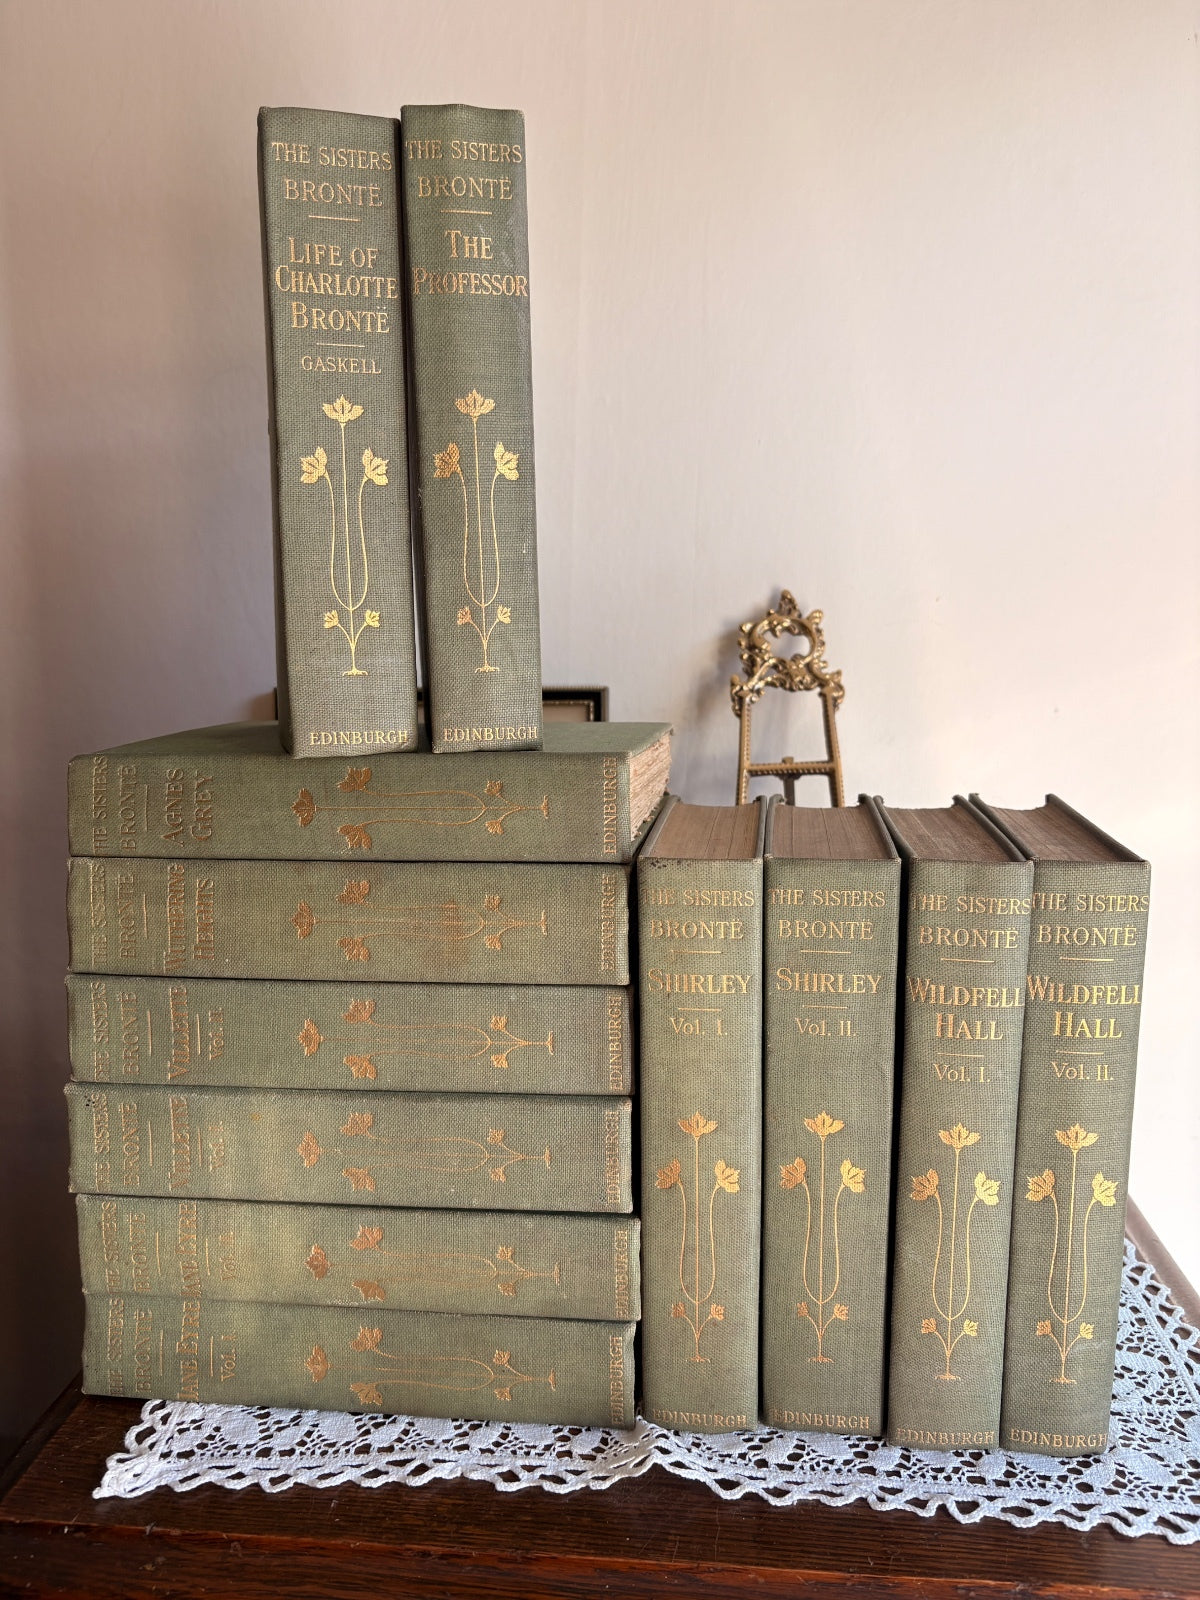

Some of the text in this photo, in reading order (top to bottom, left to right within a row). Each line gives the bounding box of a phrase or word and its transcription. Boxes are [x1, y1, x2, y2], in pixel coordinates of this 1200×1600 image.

[271, 142, 393, 171] THE SISTERS
[405, 140, 523, 164] THE SISTERS
[284, 178, 382, 208] BRONTË
[418, 175, 512, 200] BRONTË
[288, 237, 378, 268] LIFE OF
[445, 230, 493, 260] THE
[275, 265, 398, 299] CHARLOTTE
[412, 267, 528, 297] PROFESSOR
[291, 302, 390, 333] BRONTË
[301, 356, 381, 374] GASKELL
[310, 730, 408, 745] EDINBURGH
[443, 726, 538, 742] EDINBURGH
[92, 755, 108, 819] SISTERS
[161, 768, 185, 847] AGNES
[190, 770, 214, 842] GREY
[603, 757, 617, 855] EDINBURGH
[643, 890, 755, 907] THE SISTERS
[768, 889, 886, 907] THE SISTERS
[957, 895, 1031, 915] SISTERS
[1076, 894, 1149, 912] SISTERS
[163, 864, 186, 973] WUTHERING
[193, 878, 215, 961] HEIGHTS
[650, 919, 744, 940] BRONTË
[778, 919, 874, 940] BRONTË
[919, 926, 1018, 949] BRONTË
[1037, 924, 1137, 946] BRONTË
[648, 968, 751, 994] SHIRLEY
[776, 968, 882, 994] SHIRLEY
[907, 976, 1025, 1008] WILDFELL
[91, 981, 109, 1044] SISTERS
[935, 1012, 1004, 1040] HALL
[1053, 1011, 1123, 1039] HALL
[167, 985, 190, 1080] VILLETTE
[670, 1017, 706, 1036] Vol.
[795, 1017, 831, 1036] Vol.
[608, 996, 623, 1092] EDINBURGH
[933, 1063, 971, 1082] Vol.
[1050, 1061, 1090, 1081] Vol.
[168, 1096, 190, 1191] VILLETTE
[174, 1202, 197, 1256] EYRE
[176, 1300, 201, 1401] JANE EYRE
[609, 1336, 624, 1426] EDINBURGH
[652, 1409, 748, 1428] EDINBURGH
[773, 1410, 870, 1430] EDINBURGH
[896, 1428, 994, 1446] EDINBURGH
[1010, 1428, 1109, 1447] EDINBURGH
